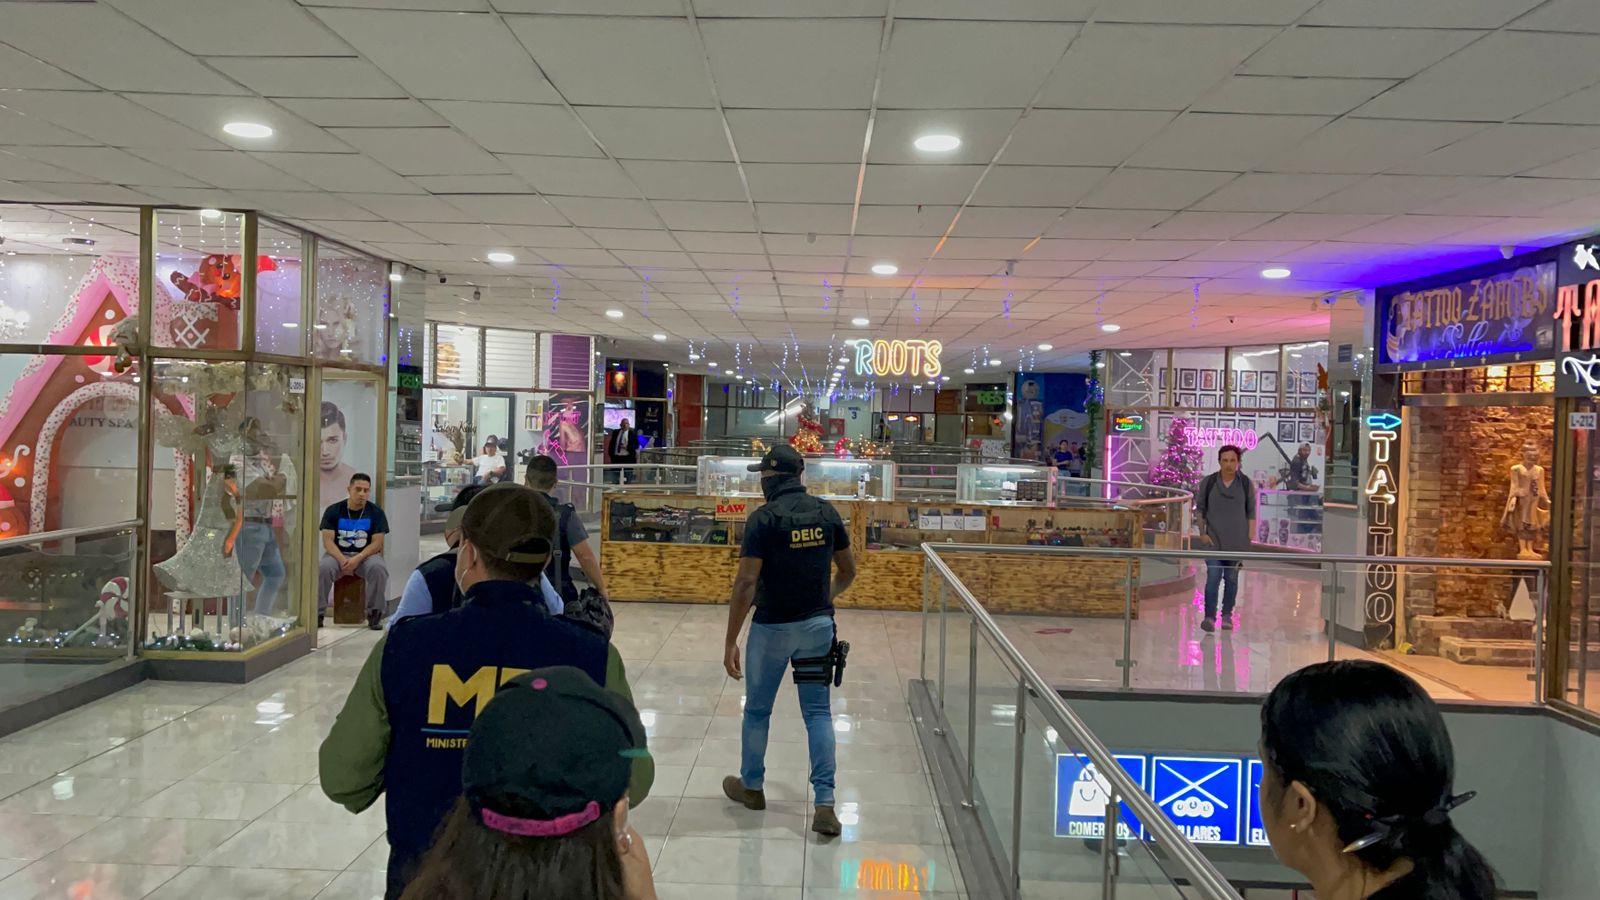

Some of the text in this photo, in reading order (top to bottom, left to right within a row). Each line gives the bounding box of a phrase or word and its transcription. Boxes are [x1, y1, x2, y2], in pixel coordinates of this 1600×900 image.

[854, 338, 943, 378] ROOTS
[69, 416, 105, 428] AUTY
[1570, 415, 1595, 429] L-212
[1184, 426, 1258, 451] TATTOO
[716, 503, 746, 513] RAW
[791, 527, 824, 543] DEIC
[1365, 430, 1397, 623] TATTOO
[1069, 821, 1130, 839] COMEROS
